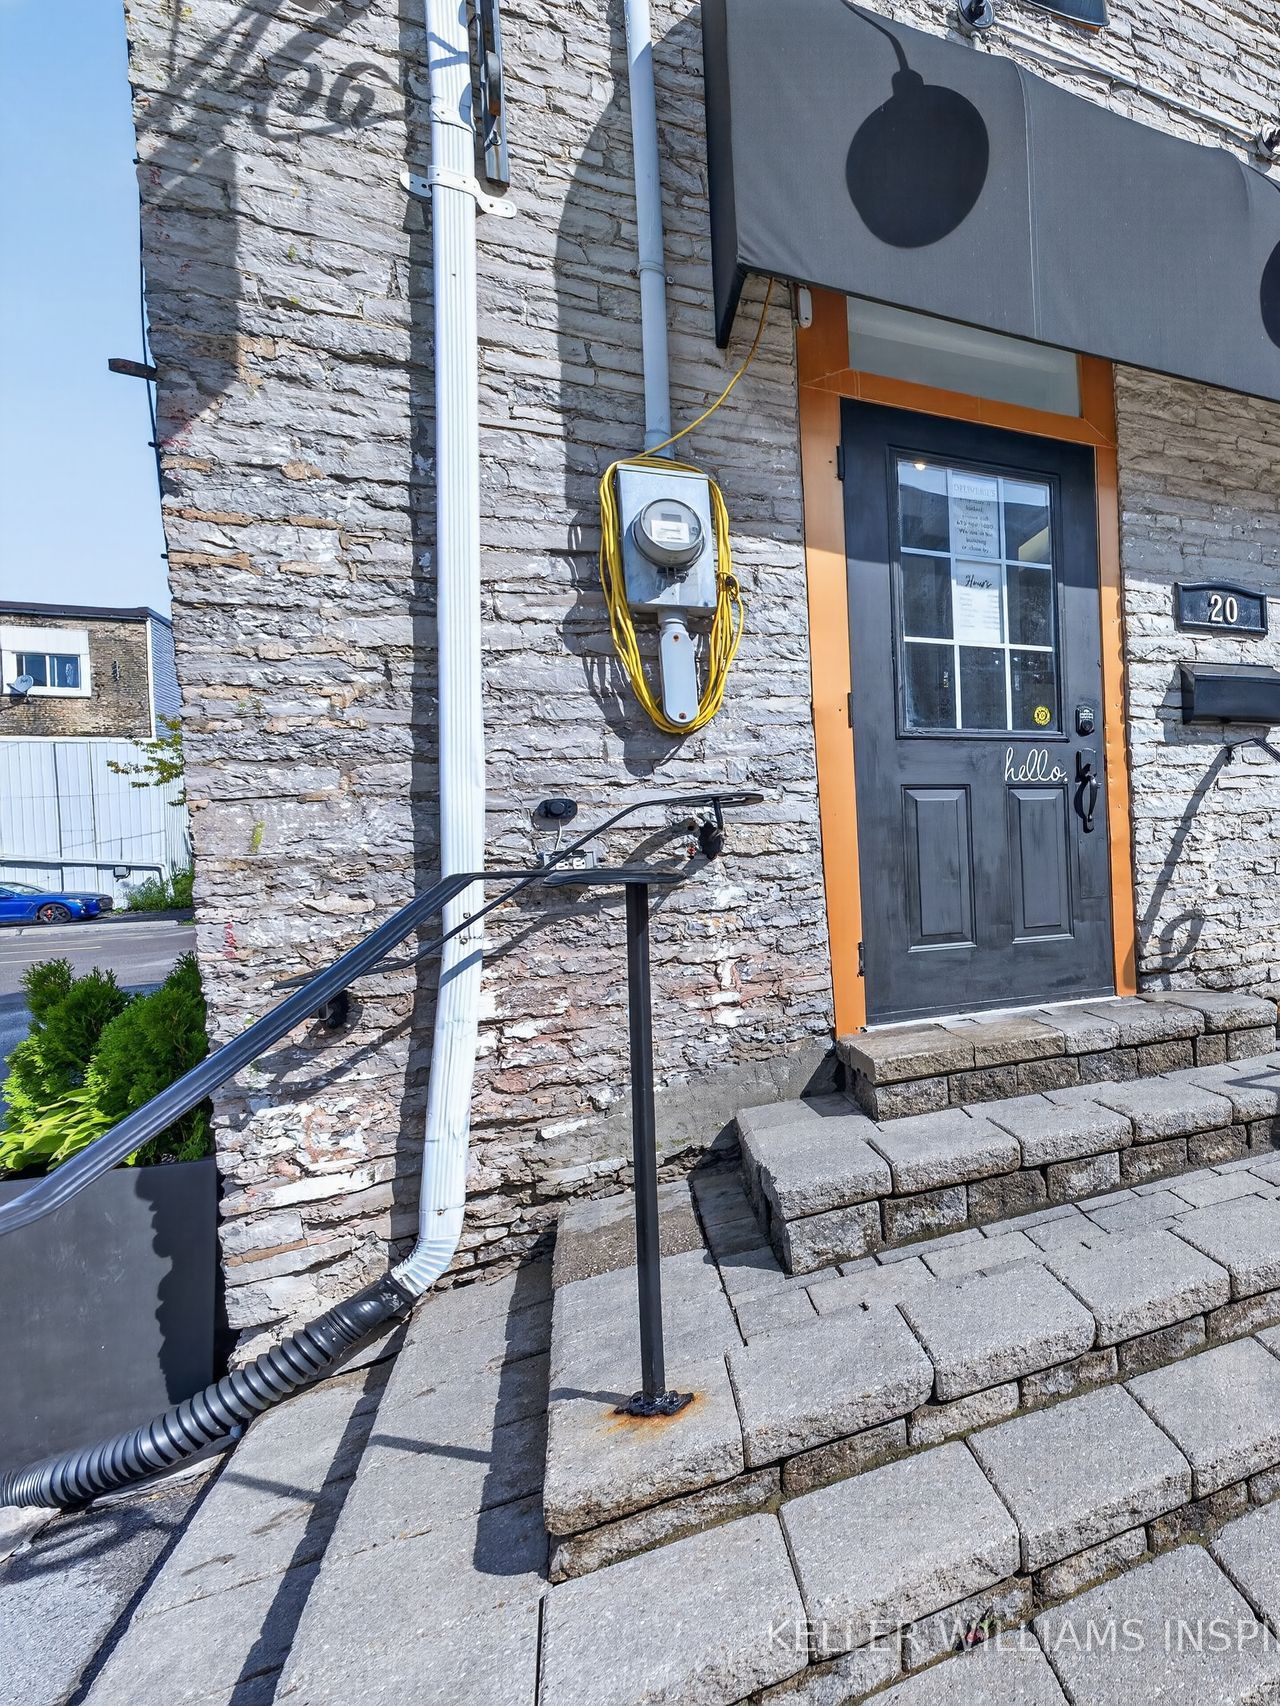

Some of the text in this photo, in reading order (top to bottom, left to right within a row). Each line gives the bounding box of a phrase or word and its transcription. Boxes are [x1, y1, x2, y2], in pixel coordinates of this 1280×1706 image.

[965, 574, 993, 589] Hours
[1210, 593, 1239, 624] 20
[1004, 746, 1068, 782] hello.
